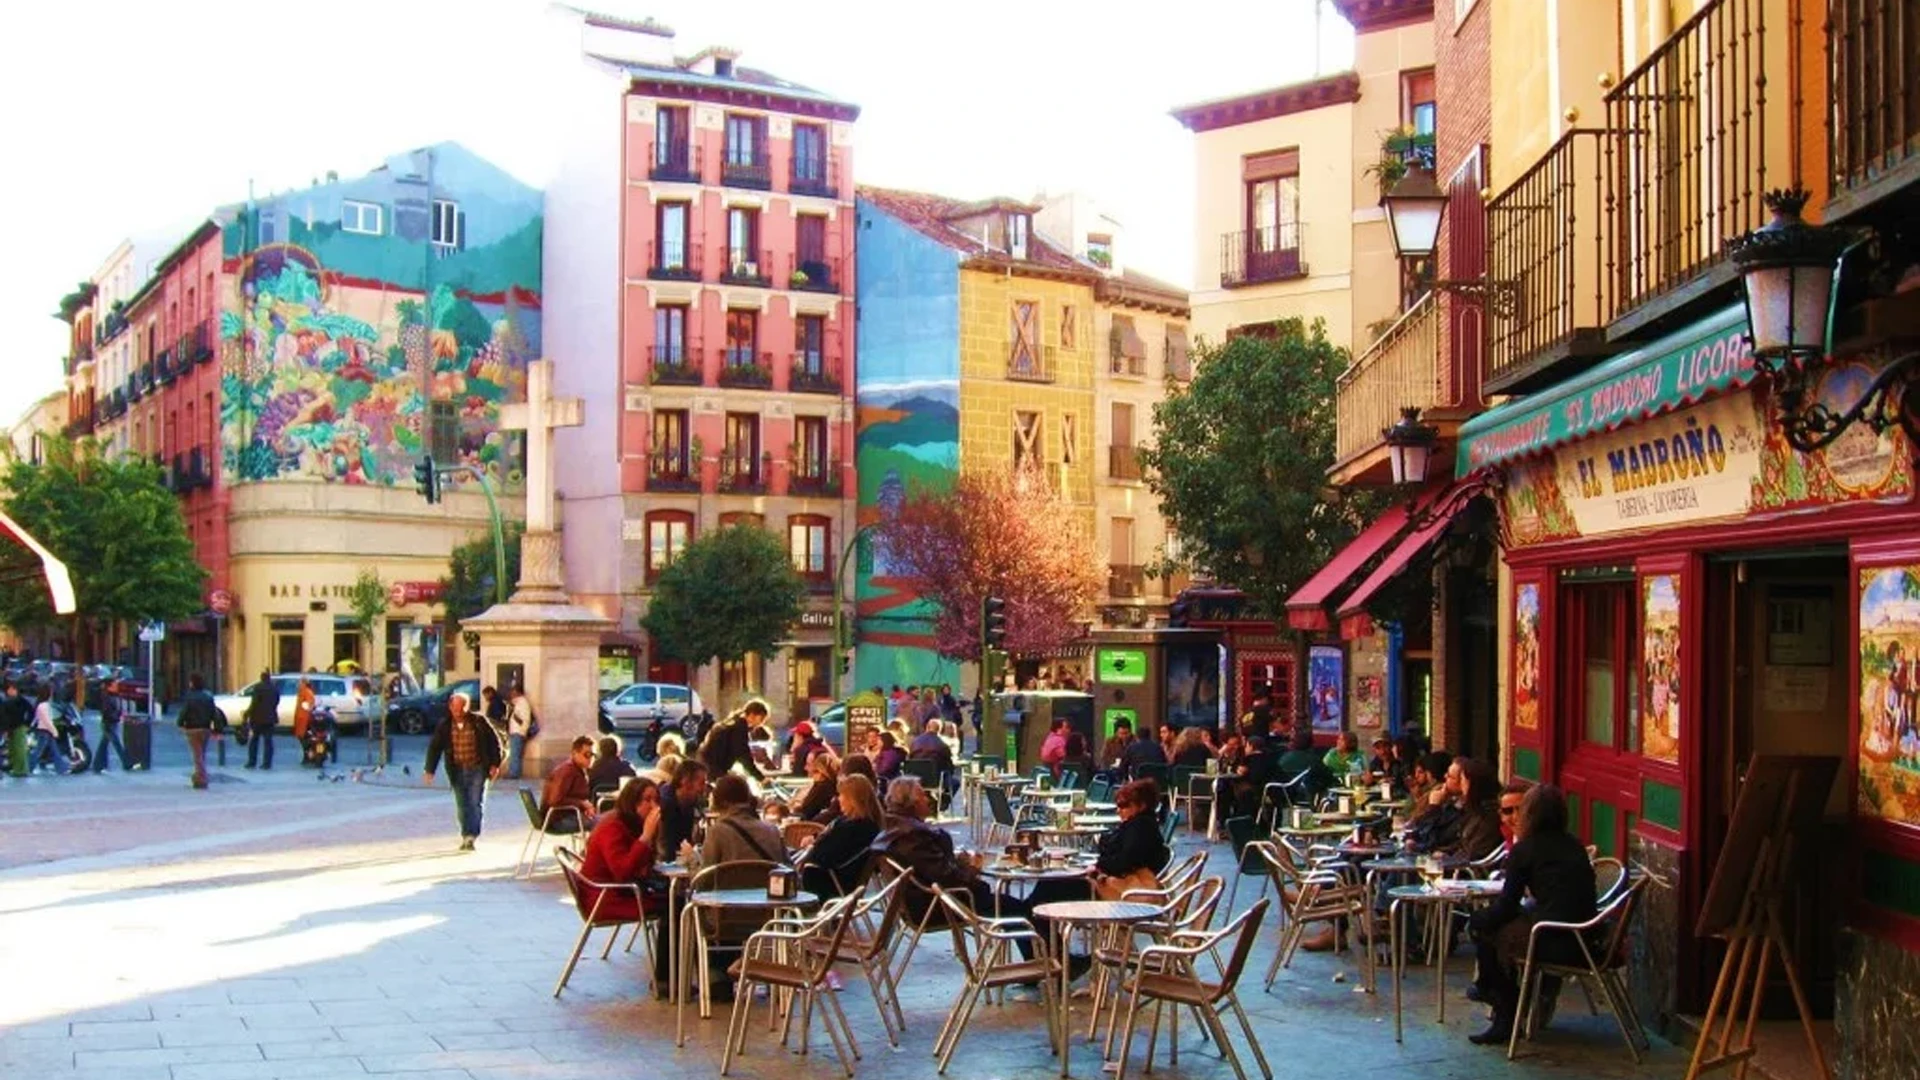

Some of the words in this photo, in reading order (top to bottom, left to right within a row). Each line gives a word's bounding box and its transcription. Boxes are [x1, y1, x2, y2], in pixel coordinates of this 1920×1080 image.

[1676, 328, 1756, 390] LICORE
[1577, 457, 1602, 499] EL
[1607, 416, 1726, 493] MADROÑO
